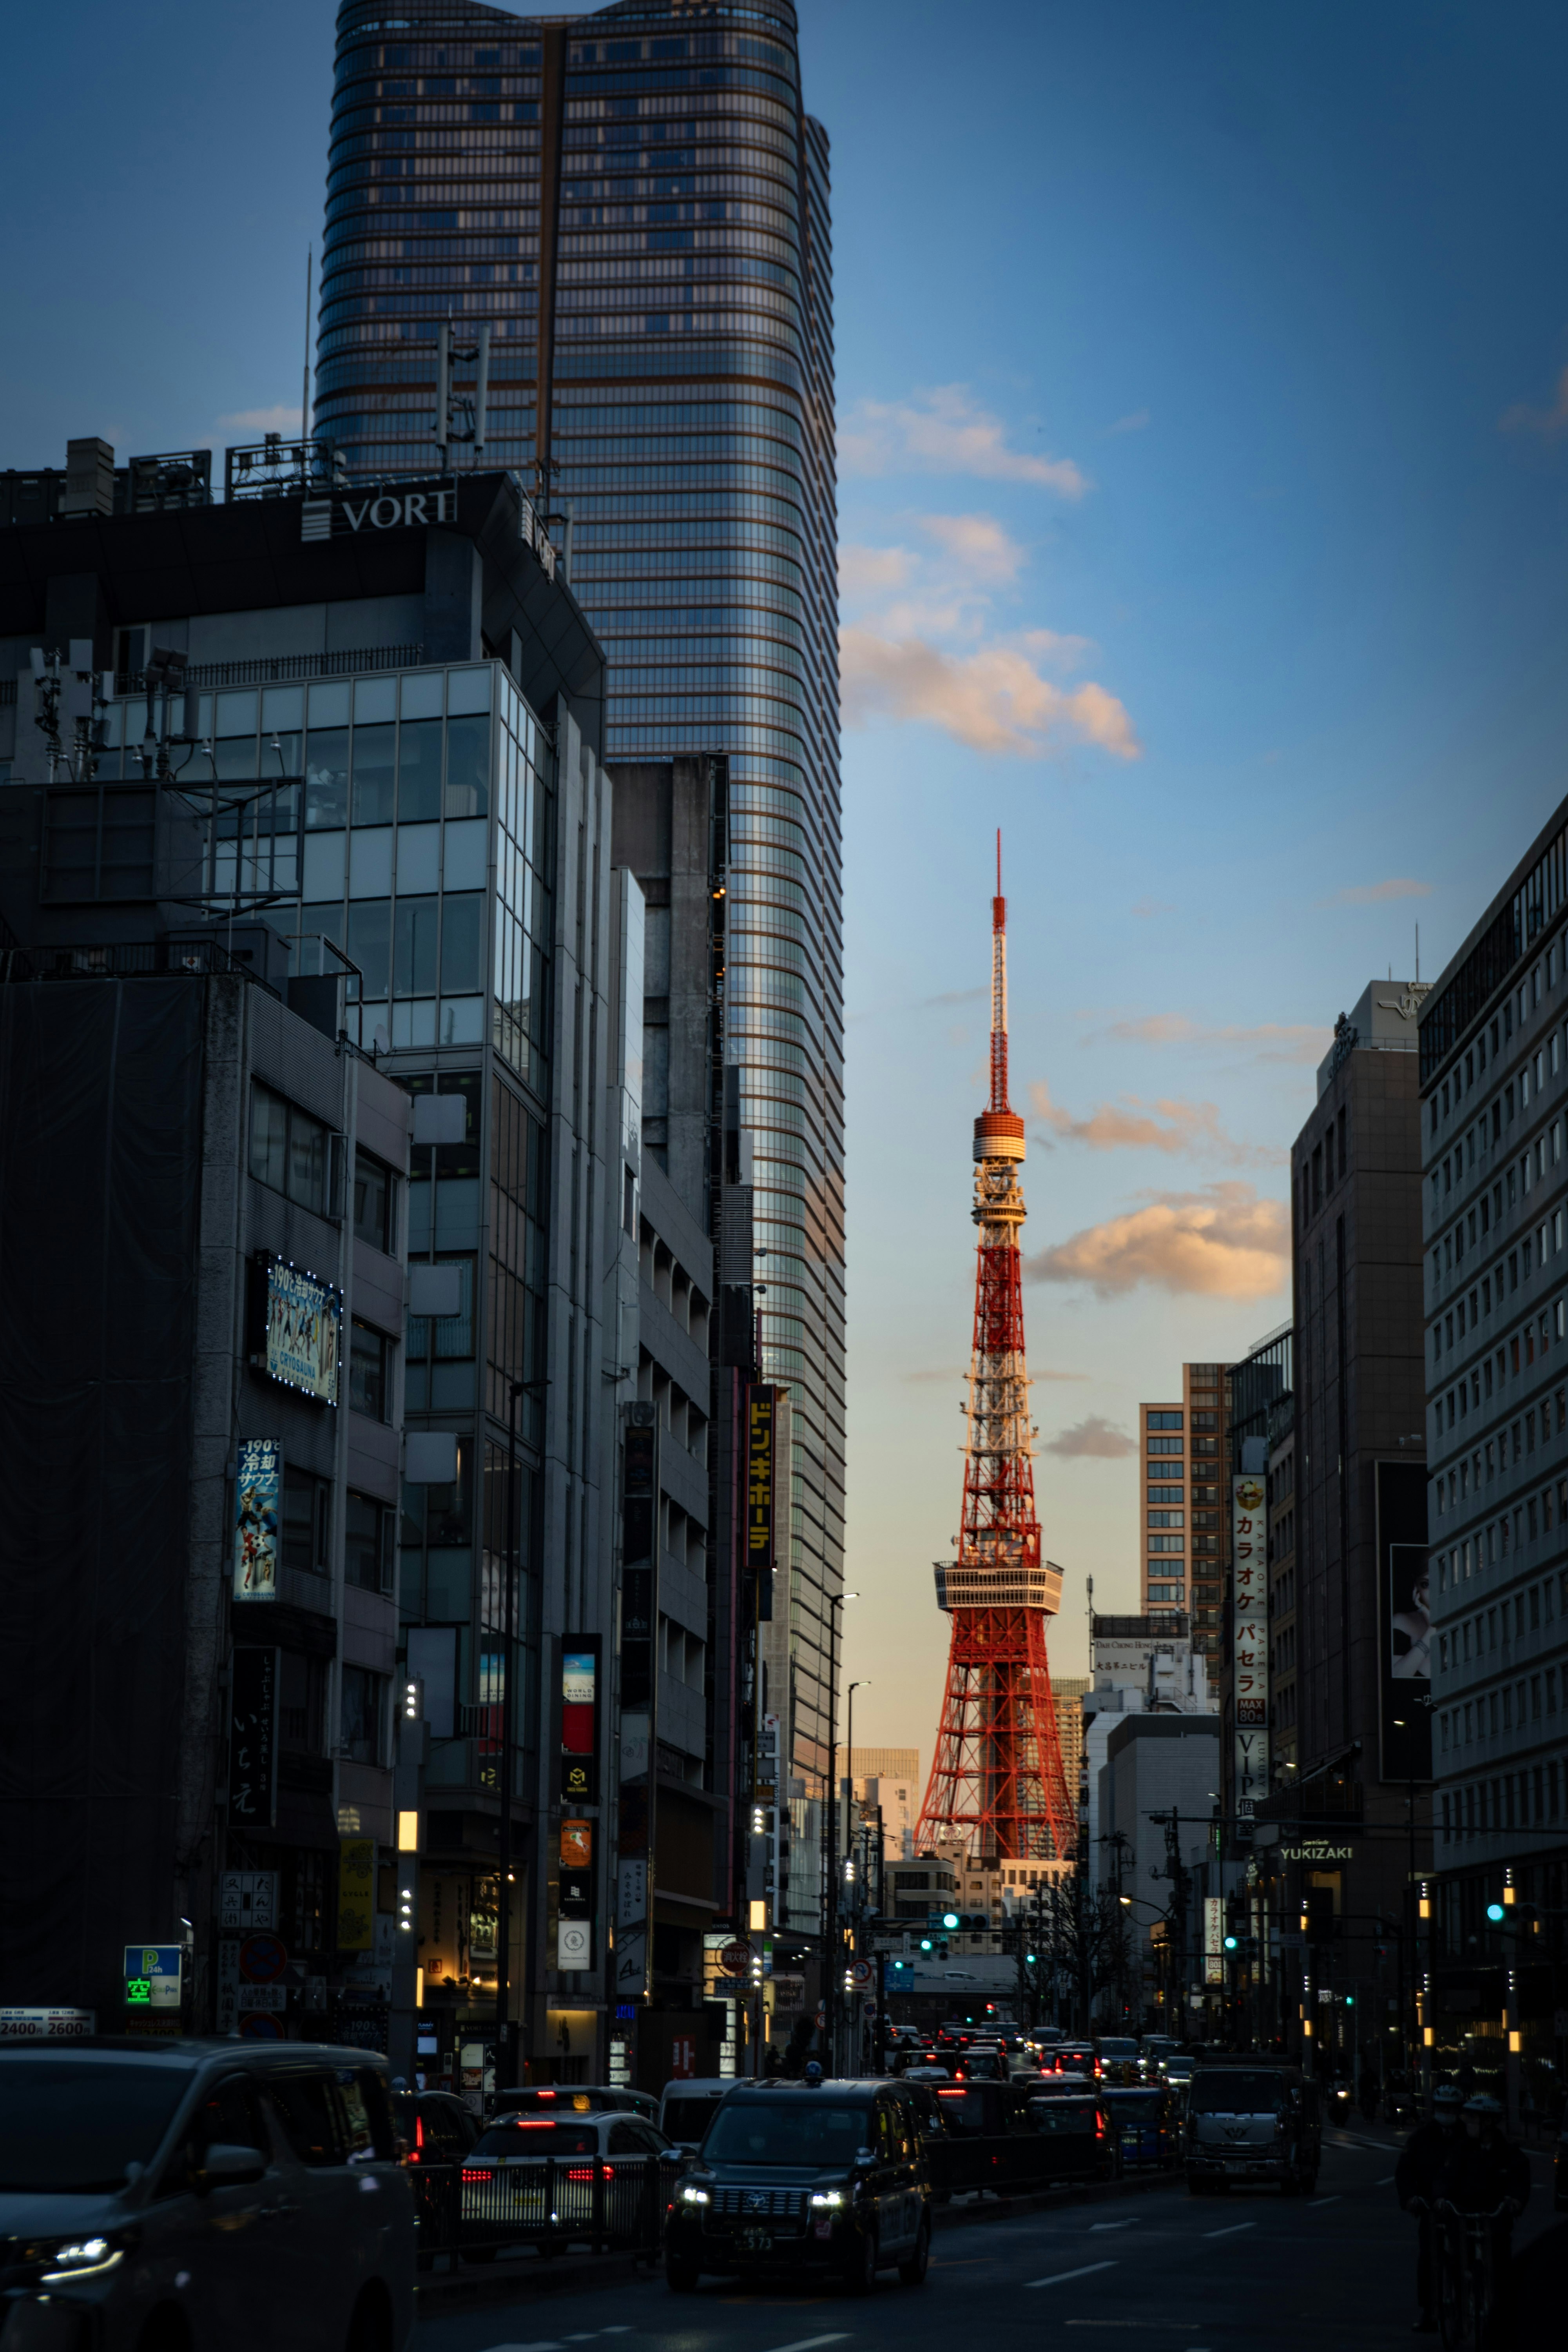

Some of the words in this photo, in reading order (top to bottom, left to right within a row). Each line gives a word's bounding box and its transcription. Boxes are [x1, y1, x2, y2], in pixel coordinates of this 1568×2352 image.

[341, 490, 455, 532] VORT
[280, 1350, 315, 1380] CRYOSAUNA
[241, 1453, 276, 1472] 冷却
[237, 1470, 279, 1488] サウナ
[749, 1403, 771, 1549] ドン・キホーテ
[1236, 1516, 1255, 1610] カラオケ
[1236, 1624, 1256, 1693] パセラ
[1239, 1710, 1263, 1722] 80名
[1240, 1700, 1263, 1709] MAX
[1280, 1847, 1353, 1860] YUKIZAKI
[142, 1949, 159, 1974] P
[723, 1951, 748, 1963] 消火栓
[127, 1978, 150, 2001] 空
